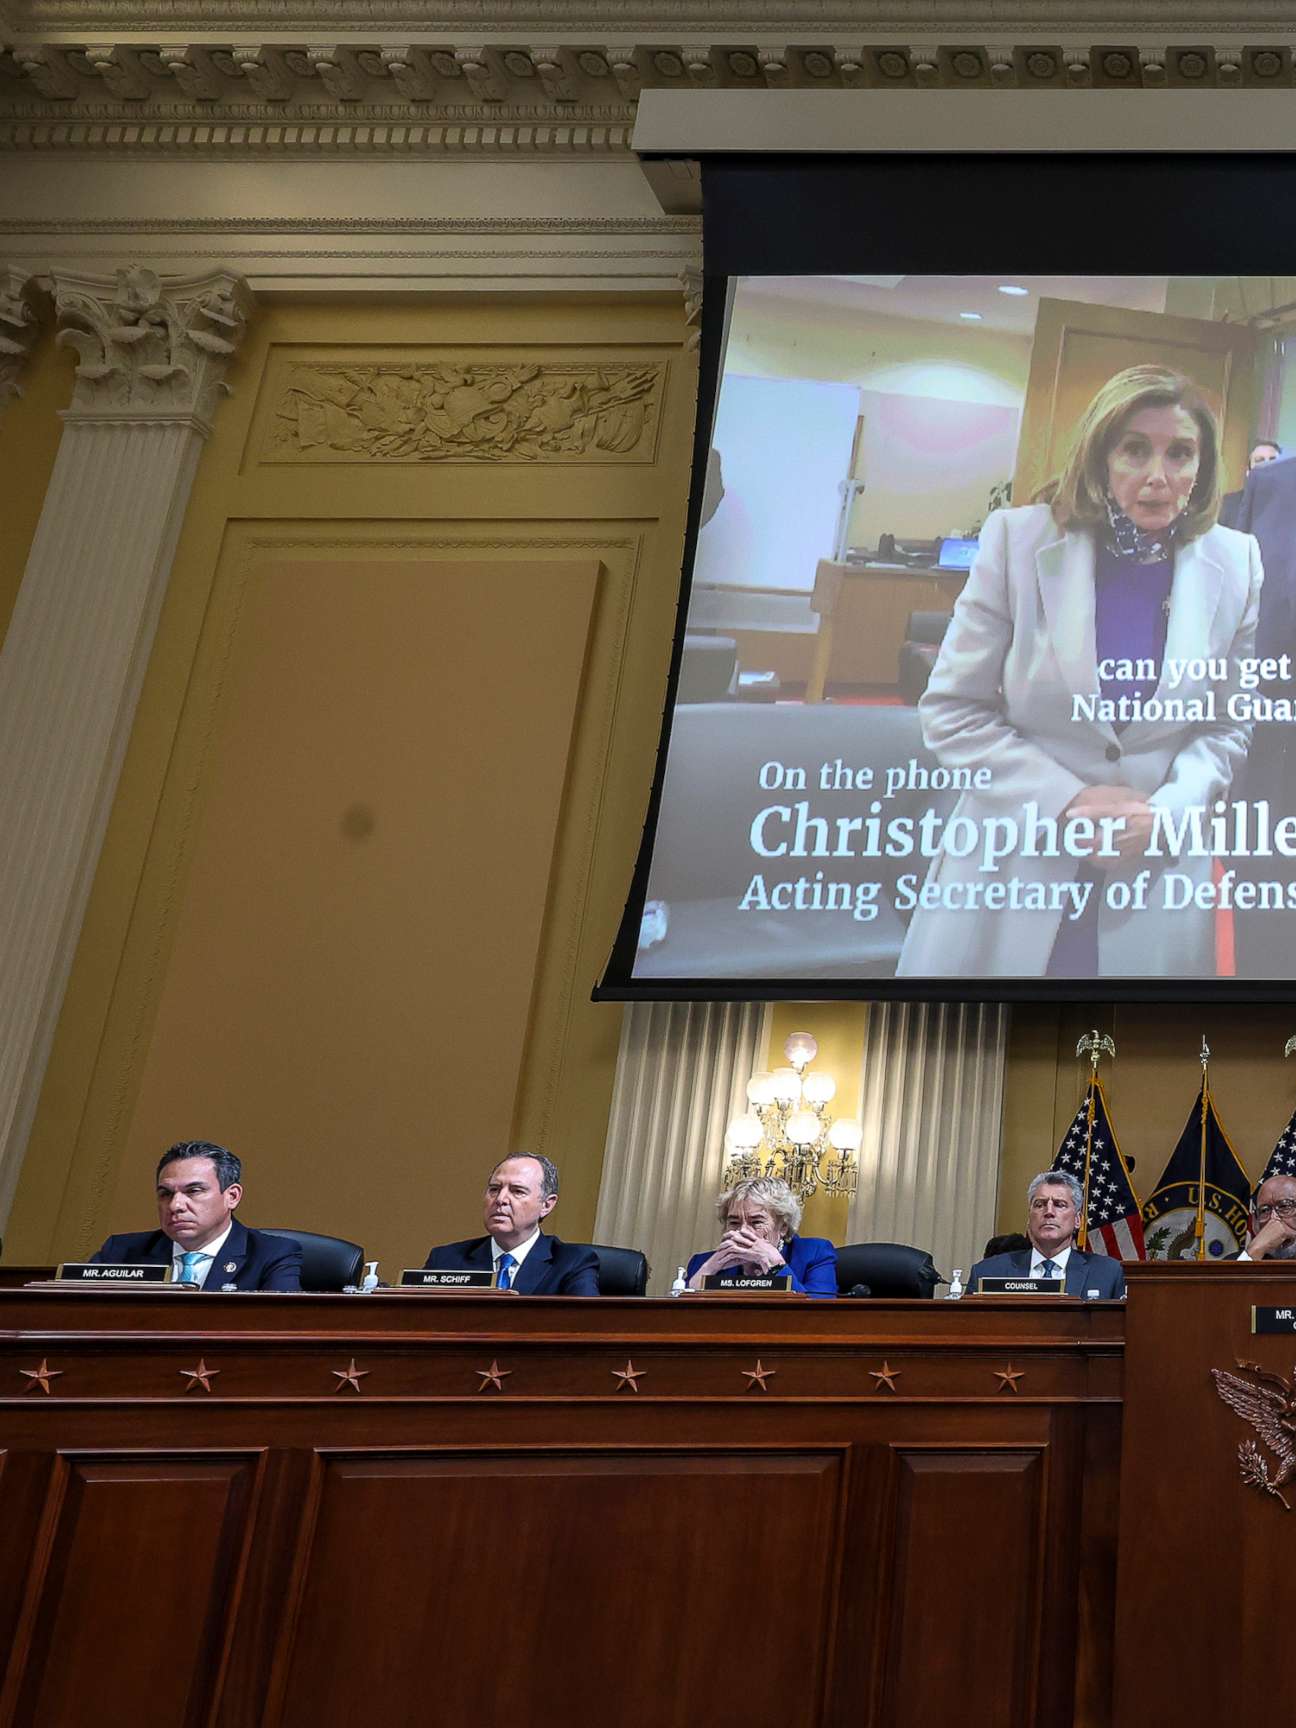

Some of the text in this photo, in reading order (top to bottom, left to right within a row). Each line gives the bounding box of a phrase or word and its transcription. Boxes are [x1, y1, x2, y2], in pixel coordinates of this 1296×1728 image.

[1099, 658, 1157, 681] can
[1168, 657, 1228, 689] you
[1239, 653, 1292, 689] get
[1071, 691, 1216, 722] National
[758, 759, 993, 798] On the phone
[750, 801, 1127, 872] Christopher
[737, 871, 882, 922] Acting
[894, 873, 1093, 921] Secretary
[1106, 870, 1150, 910] of
[82, 1269, 144, 1278] MR. AGUILAR
[423, 1275, 471, 1284] MR. SCHIFF
[720, 1279, 773, 1287] MS. LOFGREN
[1004, 1282, 1039, 1290] COUNSEL
[1275, 1310, 1295, 1320] MR.
